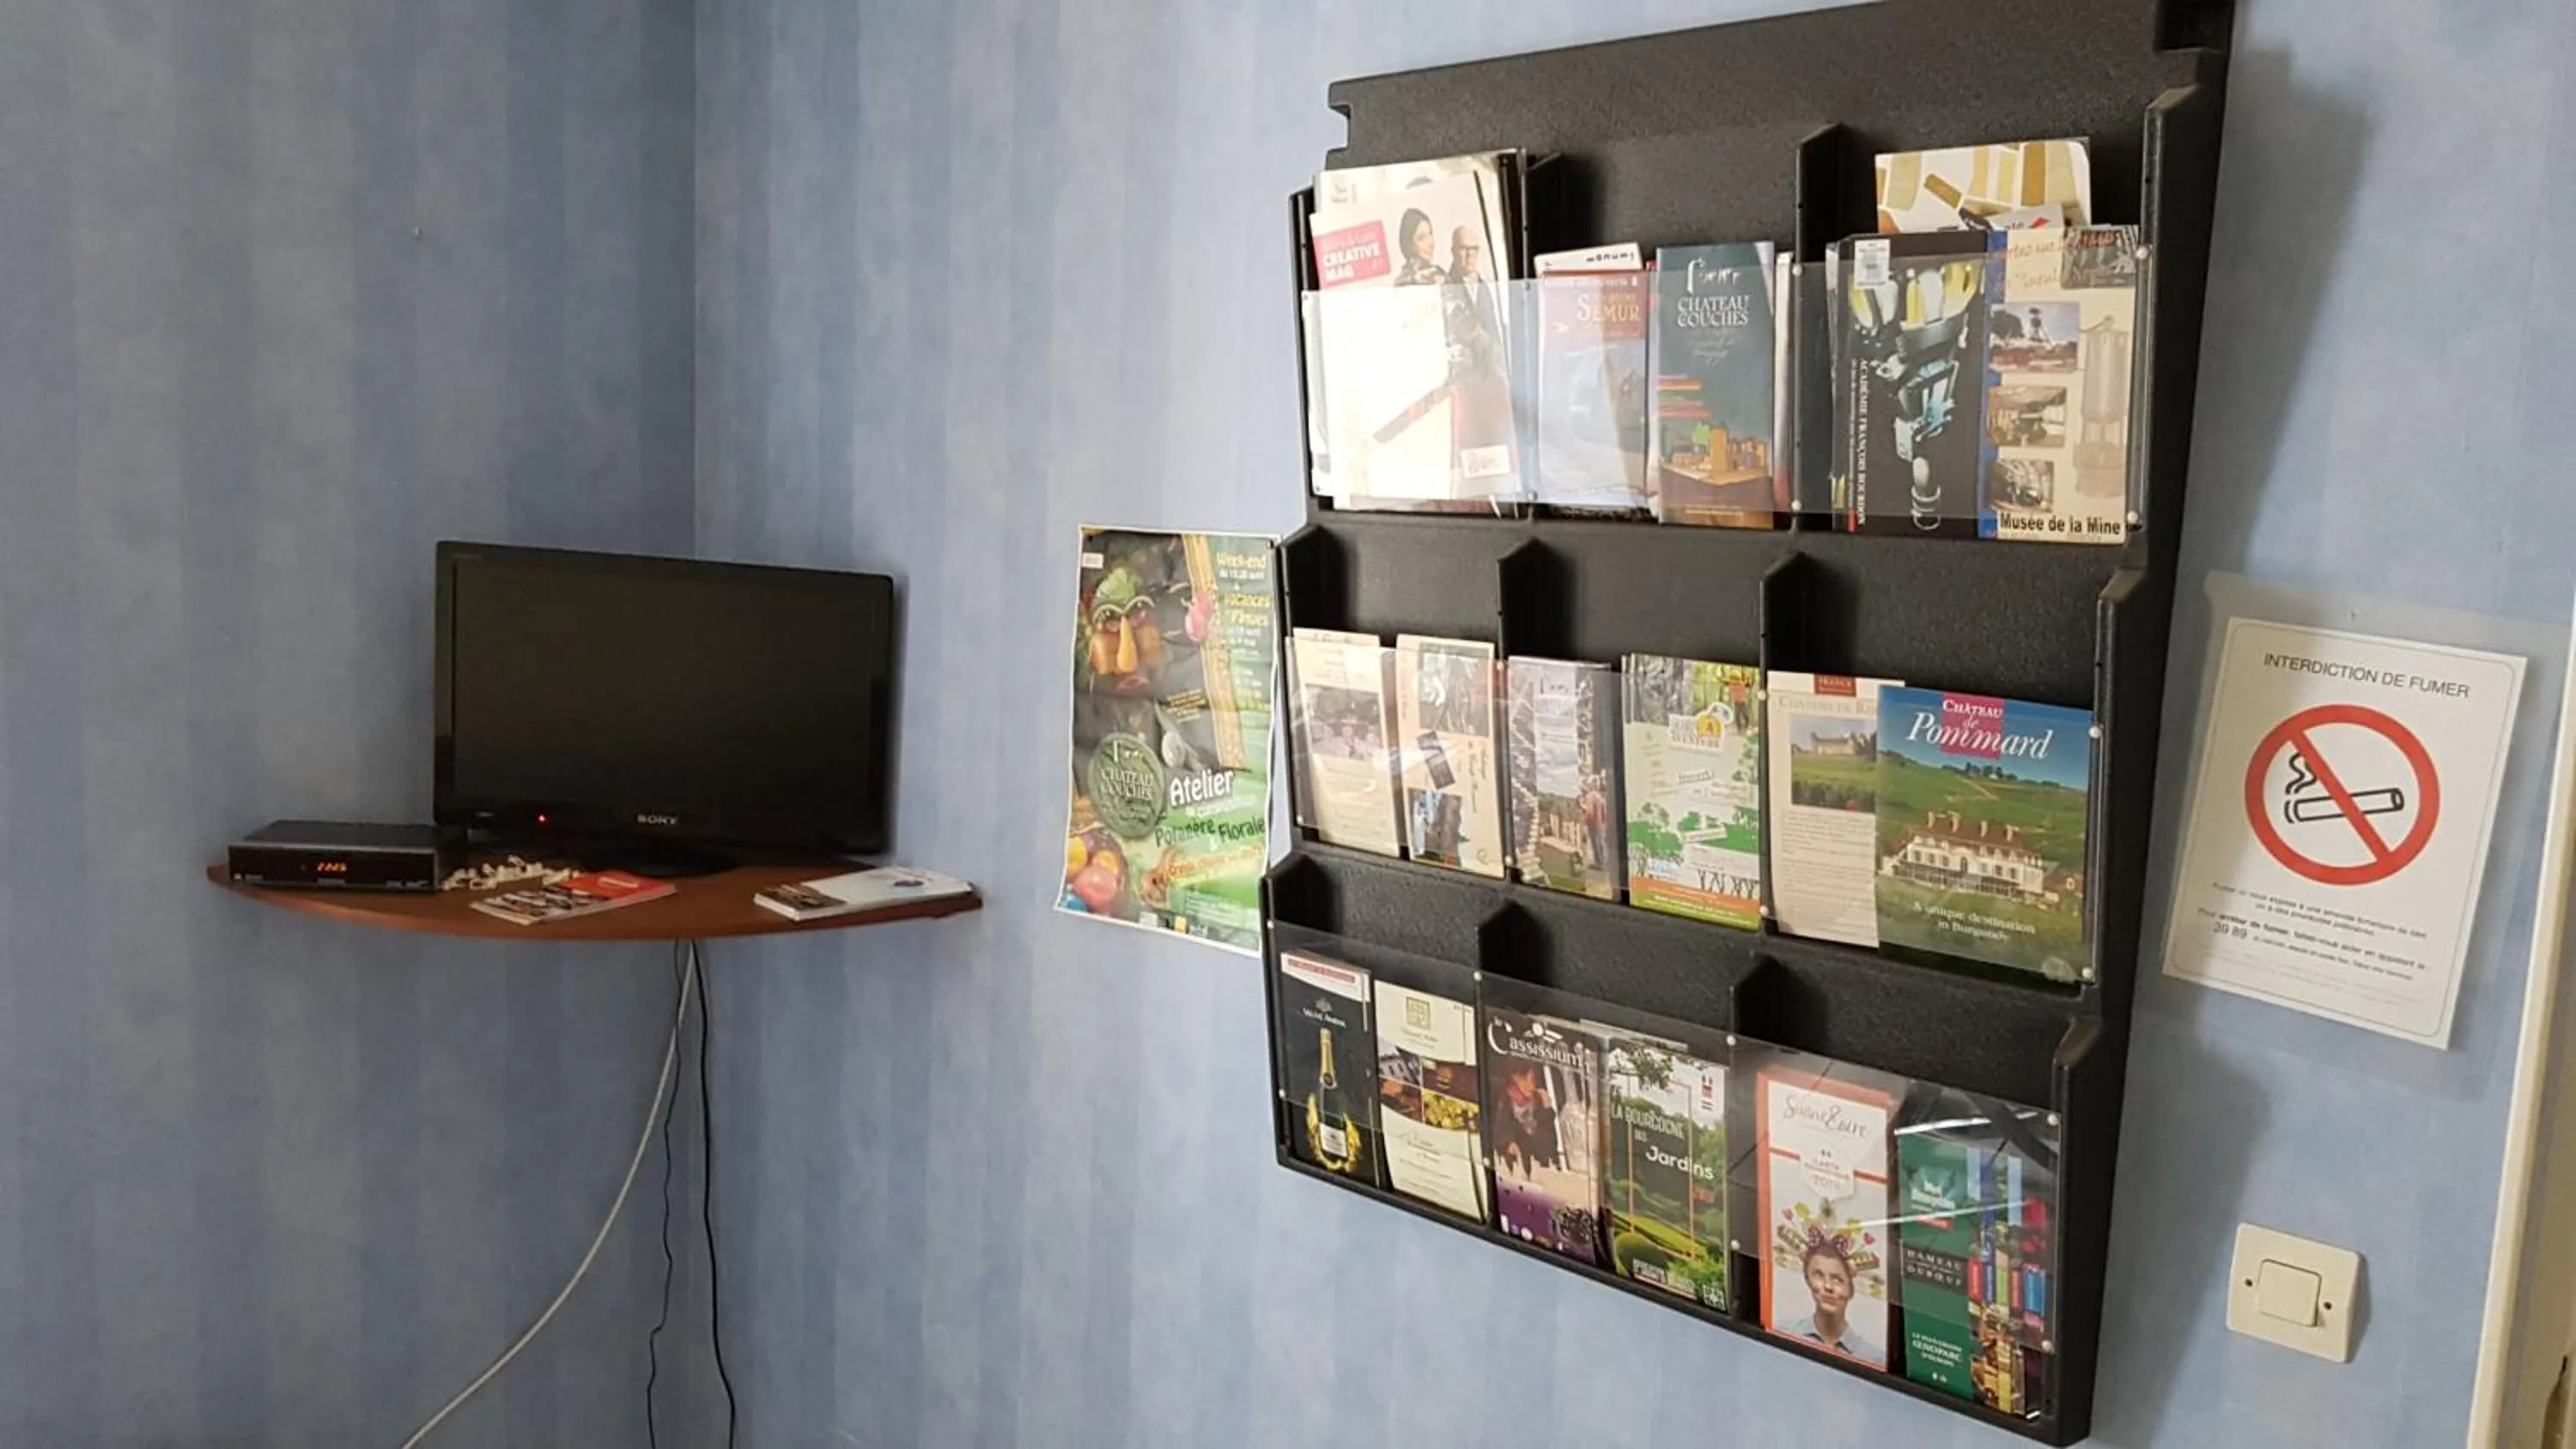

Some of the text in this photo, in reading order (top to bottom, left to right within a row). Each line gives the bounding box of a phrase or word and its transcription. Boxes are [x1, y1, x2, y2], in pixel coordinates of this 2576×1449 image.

[1323, 241, 1381, 268] CREATIVE
[1324, 264, 1354, 282] MAG
[1577, 293, 1640, 323] SEMUR
[2049, 515, 2065, 532] de
[2069, 516, 2082, 533] la
[2087, 516, 2121, 536] Mine
[2263, 652, 2470, 699] INTERDICTION DE FUMER
[1905, 711, 2055, 760] Pommard
[1963, 714, 1979, 730] de
[1170, 768, 1234, 807] Atelier
[636, 814, 678, 825] SONY
[1218, 814, 1266, 844] Florale
[1645, 1144, 1716, 1180] Jardins
